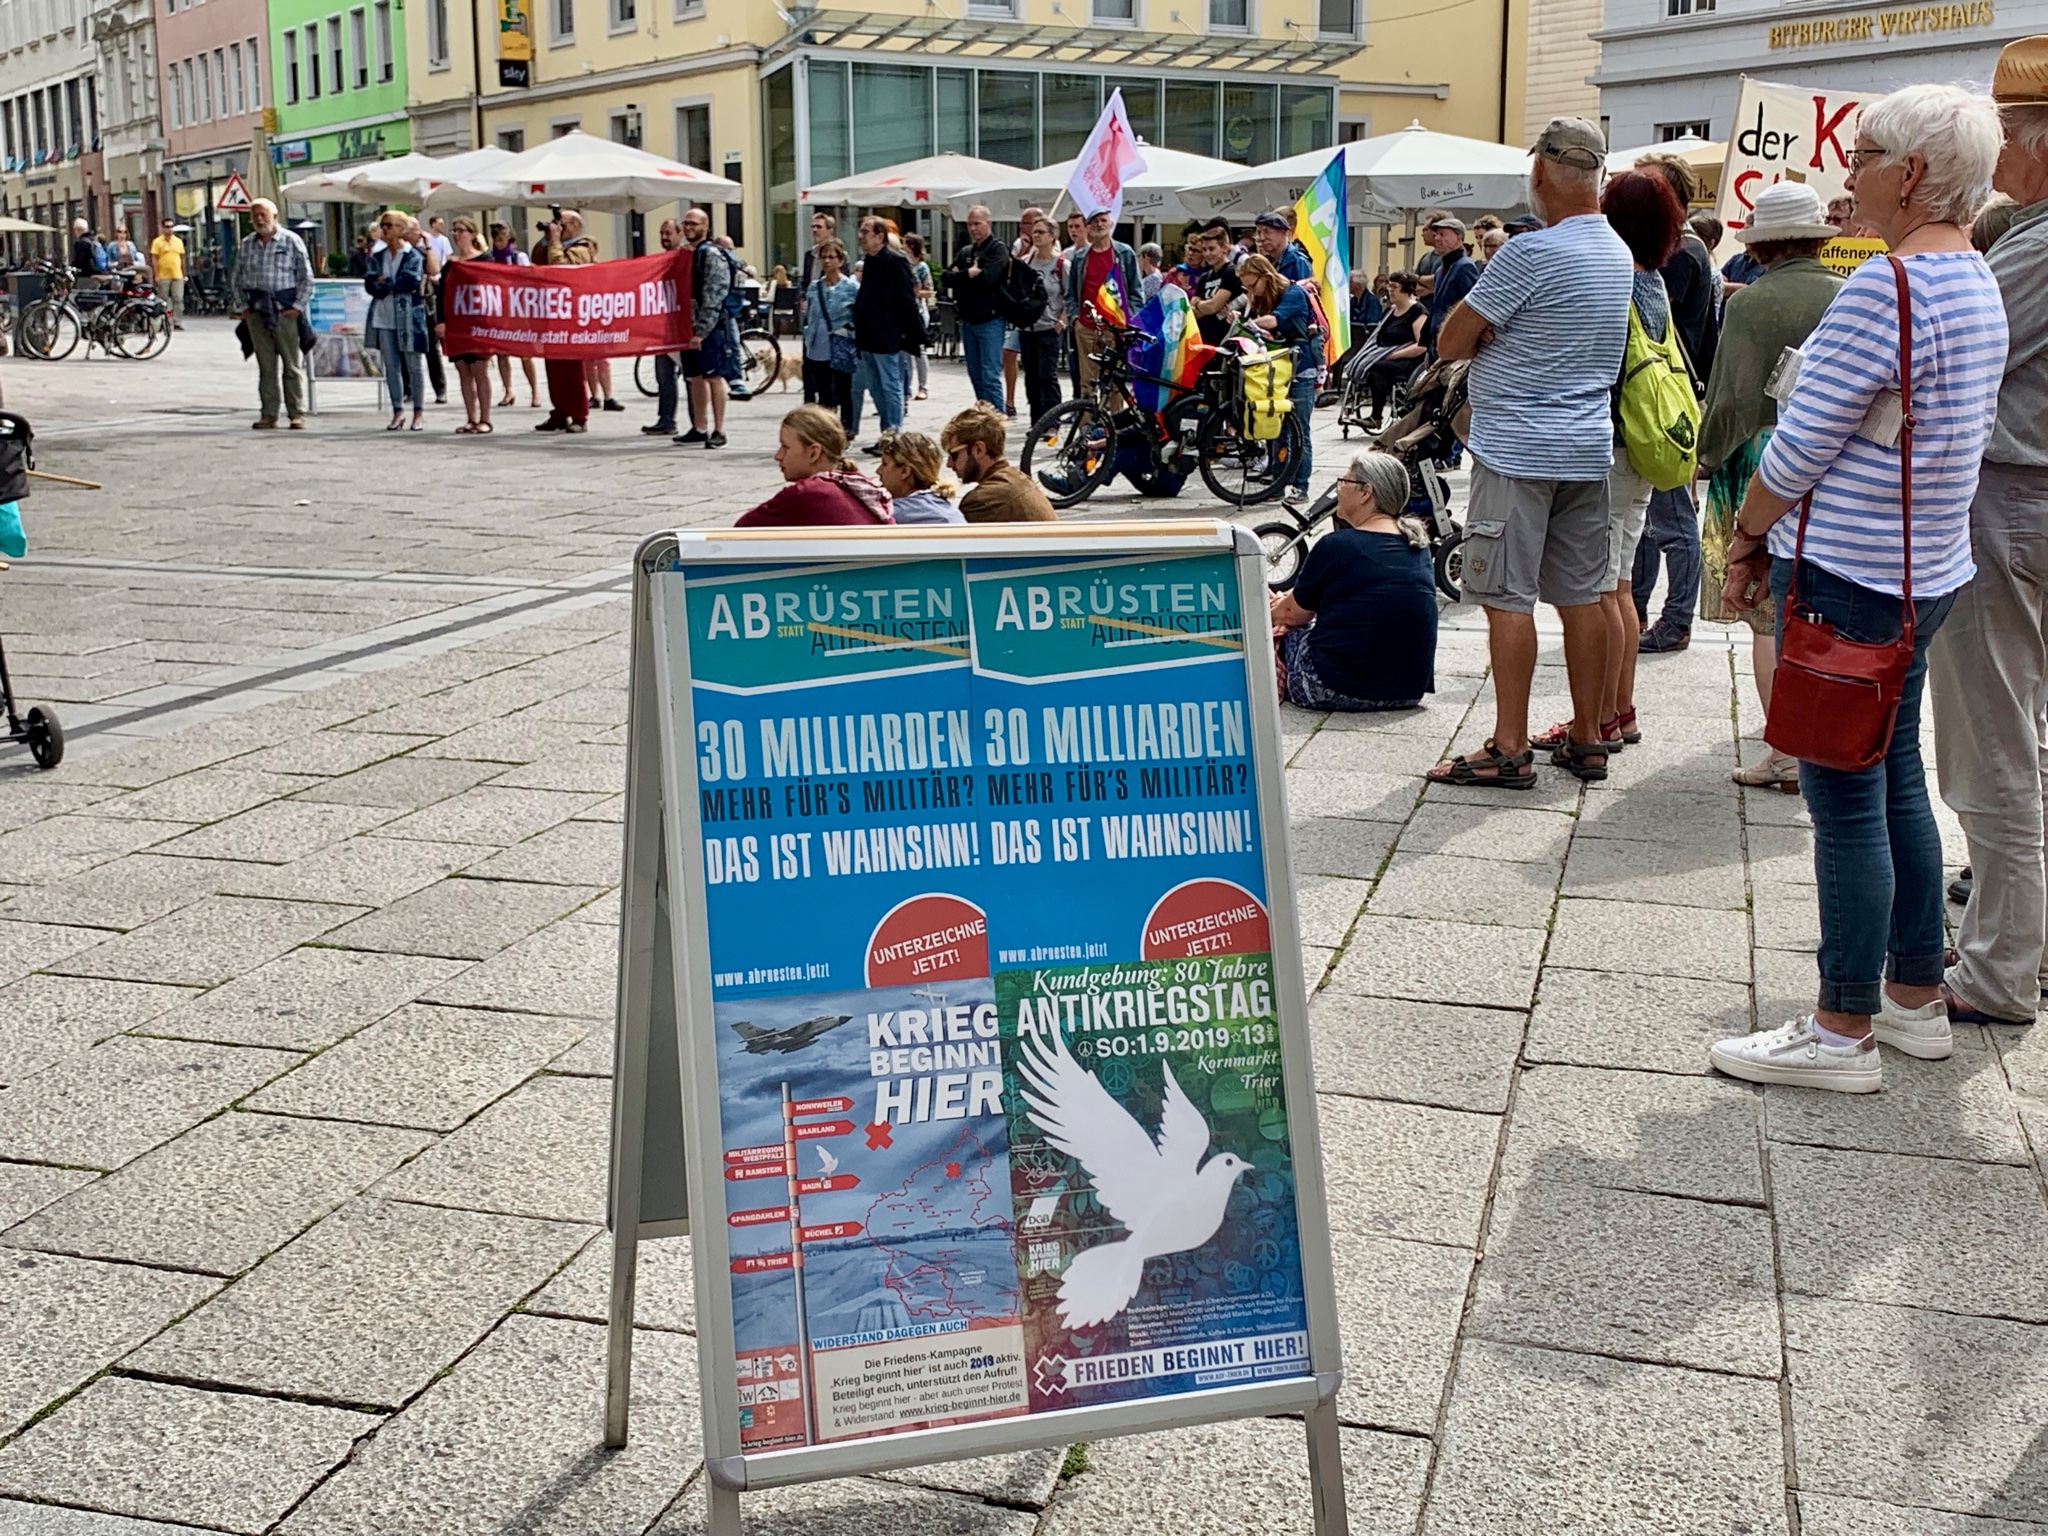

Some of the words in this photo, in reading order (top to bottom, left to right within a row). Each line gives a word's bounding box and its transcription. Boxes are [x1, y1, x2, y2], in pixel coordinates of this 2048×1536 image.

[1768, 15, 1873, 48] BITBURGER
[1877, 1, 1994, 36] WIRTSHAUS
[1738, 101, 1798, 160] der
[1420, 186, 1440, 199] Bitte
[1443, 188, 1456, 196] ein
[1457, 182, 1474, 194] Bit
[454, 284, 502, 316] KEIN
[508, 286, 572, 320] KRIEG
[578, 291, 636, 326] gegen
[640, 279, 681, 316] IRAN.
[541, 329, 569, 344] statt
[571, 328, 630, 344] eskalieren!
[707, 584, 952, 640] ABRÜSTEN
[994, 578, 1226, 632] ABRÜSTEN
[777, 624, 804, 638] STATT
[1060, 617, 1086, 630] STATT
[698, 719, 748, 782] 30
[760, 709, 973, 778] MILLIARDEN
[984, 707, 1030, 768] 30
[1042, 700, 1246, 765] MILLIARDEN
[701, 786, 773, 823] MEHR
[862, 770, 974, 814] MILITÄR?
[988, 771, 1054, 806] MEHR
[1140, 758, 1248, 800] MILITÄR?
[990, 818, 1042, 866] DAS
[1052, 816, 1092, 863] IST
[1100, 809, 1253, 860] WAHNSINN!
[705, 835, 760, 885] DAS
[770, 832, 812, 880] IST
[822, 821, 981, 877] WAHNSINN!
[1148, 903, 1258, 946] UNTERZEICHNE
[872, 918, 987, 966] UNTERZEICHNE
[1186, 932, 1232, 958] JETZT!
[714, 962, 830, 988] www.abruesten.jetzt
[912, 949, 961, 977] JETZT!
[1033, 966, 1168, 999] Kundgebung:
[1174, 962, 1200, 982] 80
[1204, 958, 1268, 989] Jahre
[1017, 979, 1272, 1037] ANTIKRIEGSTAG
[868, 1004, 1000, 1048] KRIEG
[1240, 1024, 1266, 1046] 13
[870, 1040, 1002, 1076] BEGINNT
[1198, 1050, 1278, 1074] Kornmarkt
[1240, 1074, 1279, 1090] Trier
[796, 1100, 843, 1112] NONNWEILER
[874, 1071, 1004, 1126] HIER
[798, 1125, 836, 1136] SAARLAND
[746, 1166, 782, 1176] RAMSTEIN
[731, 1210, 786, 1224] SPANGDAHLEM
[1029, 1214, 1050, 1225] DGB
[805, 1228, 834, 1238] BÜCHEL
[1029, 1241, 1060, 1253] KRIEG
[767, 1258, 788, 1266] TRIER
[1030, 1258, 1060, 1271] HIER
[813, 1331, 884, 1350] WIDERSTAND
[886, 1324, 936, 1340] DAGEGEN
[940, 1320, 968, 1332] AUCH
[863, 1369, 902, 1383] beginnt
[928, 1363, 942, 1373] ist
[944, 1360, 968, 1372] auch
[996, 1354, 1022, 1364] aktiv.
[864, 1359, 881, 1370] Die
[884, 1345, 982, 1366] Friedens-Kampagne
[1074, 1355, 1154, 1383] FRIEDEN
[1162, 1343, 1245, 1372] BEGINNT
[1254, 1336, 1304, 1360] HIER!
[832, 1387, 875, 1401] Beteiligt
[877, 1382, 904, 1394] euch,
[907, 1375, 960, 1390] unterstützt
[963, 1372, 982, 1382] den
[832, 1404, 857, 1414] Krieg
[859, 1397, 892, 1412] beginnt
[894, 1394, 911, 1405] hier
[920, 1391, 939, 1402] aber
[942, 1387, 963, 1398] auch
[966, 1384, 990, 1395] unser
[992, 1379, 1023, 1391] Protest
[834, 1418, 842, 1428] &
